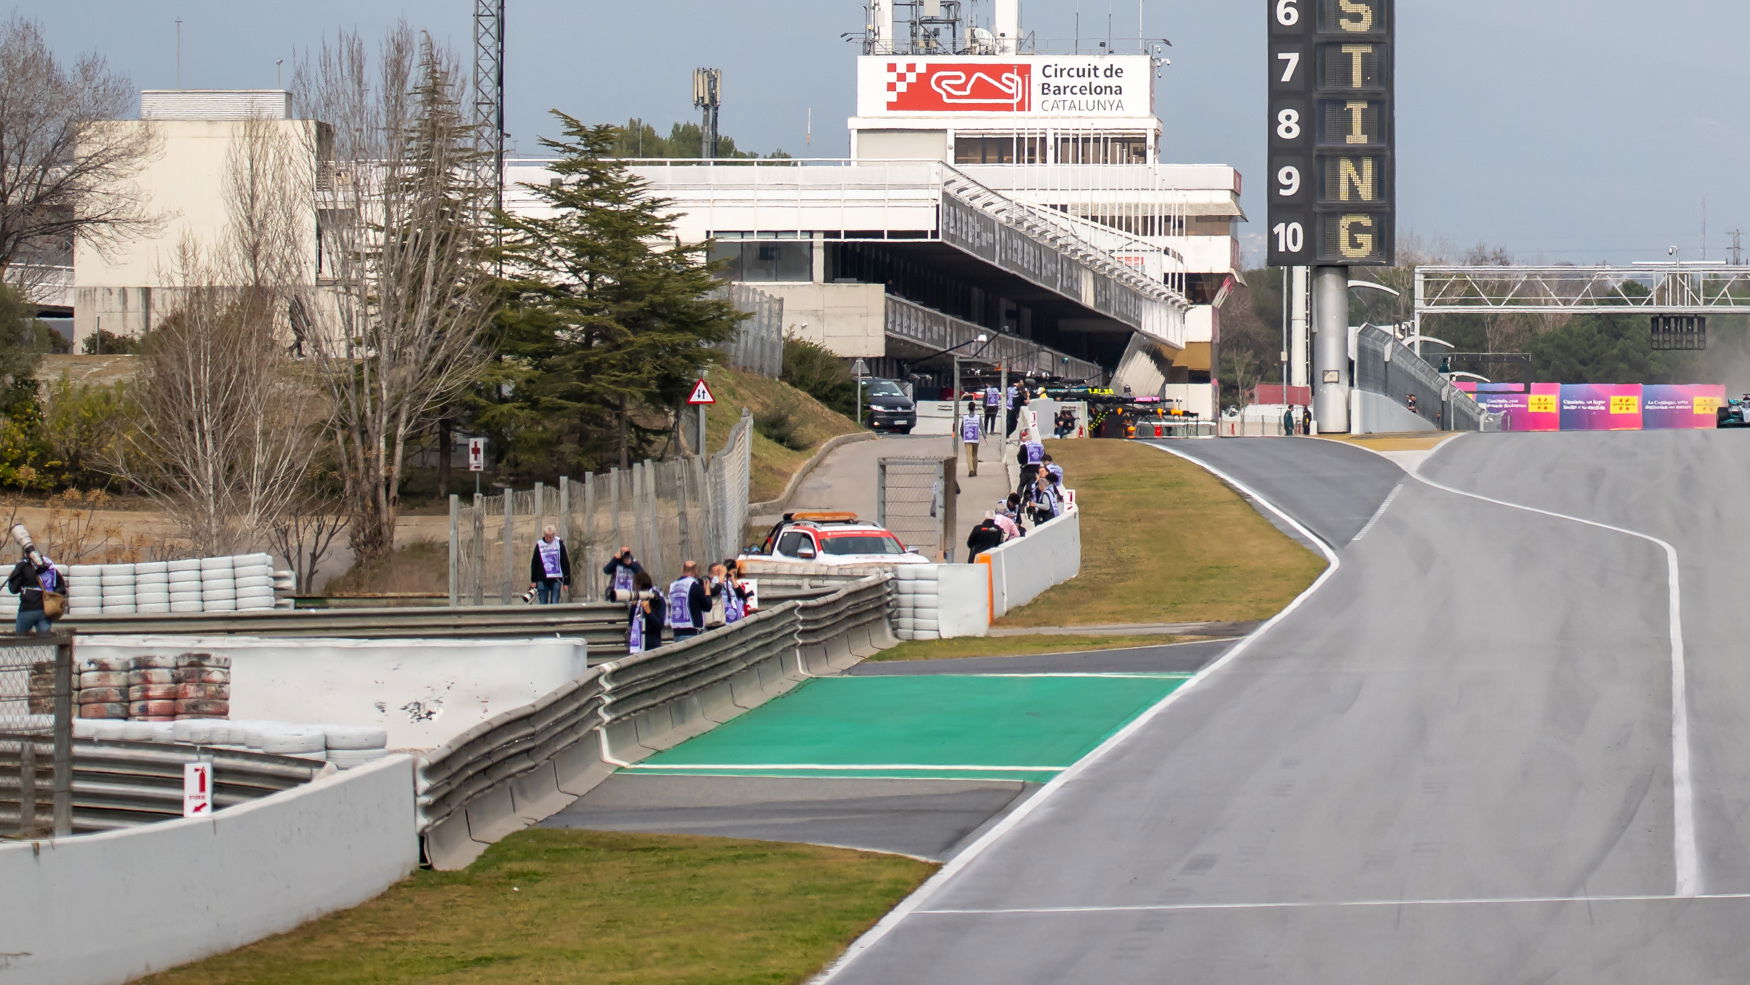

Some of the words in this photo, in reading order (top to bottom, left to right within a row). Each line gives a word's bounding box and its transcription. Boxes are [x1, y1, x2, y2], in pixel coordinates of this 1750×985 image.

[1041, 64, 1099, 79] Circuit
[1103, 63, 1124, 79] de
[1278, 53, 1300, 82] 7
[1041, 81, 1123, 96] Barcelona
[1041, 99, 1125, 112] CATALUNYA
[1277, 109, 1300, 139] 8
[1278, 166, 1301, 196] 9
[1273, 222, 1304, 252] 10
